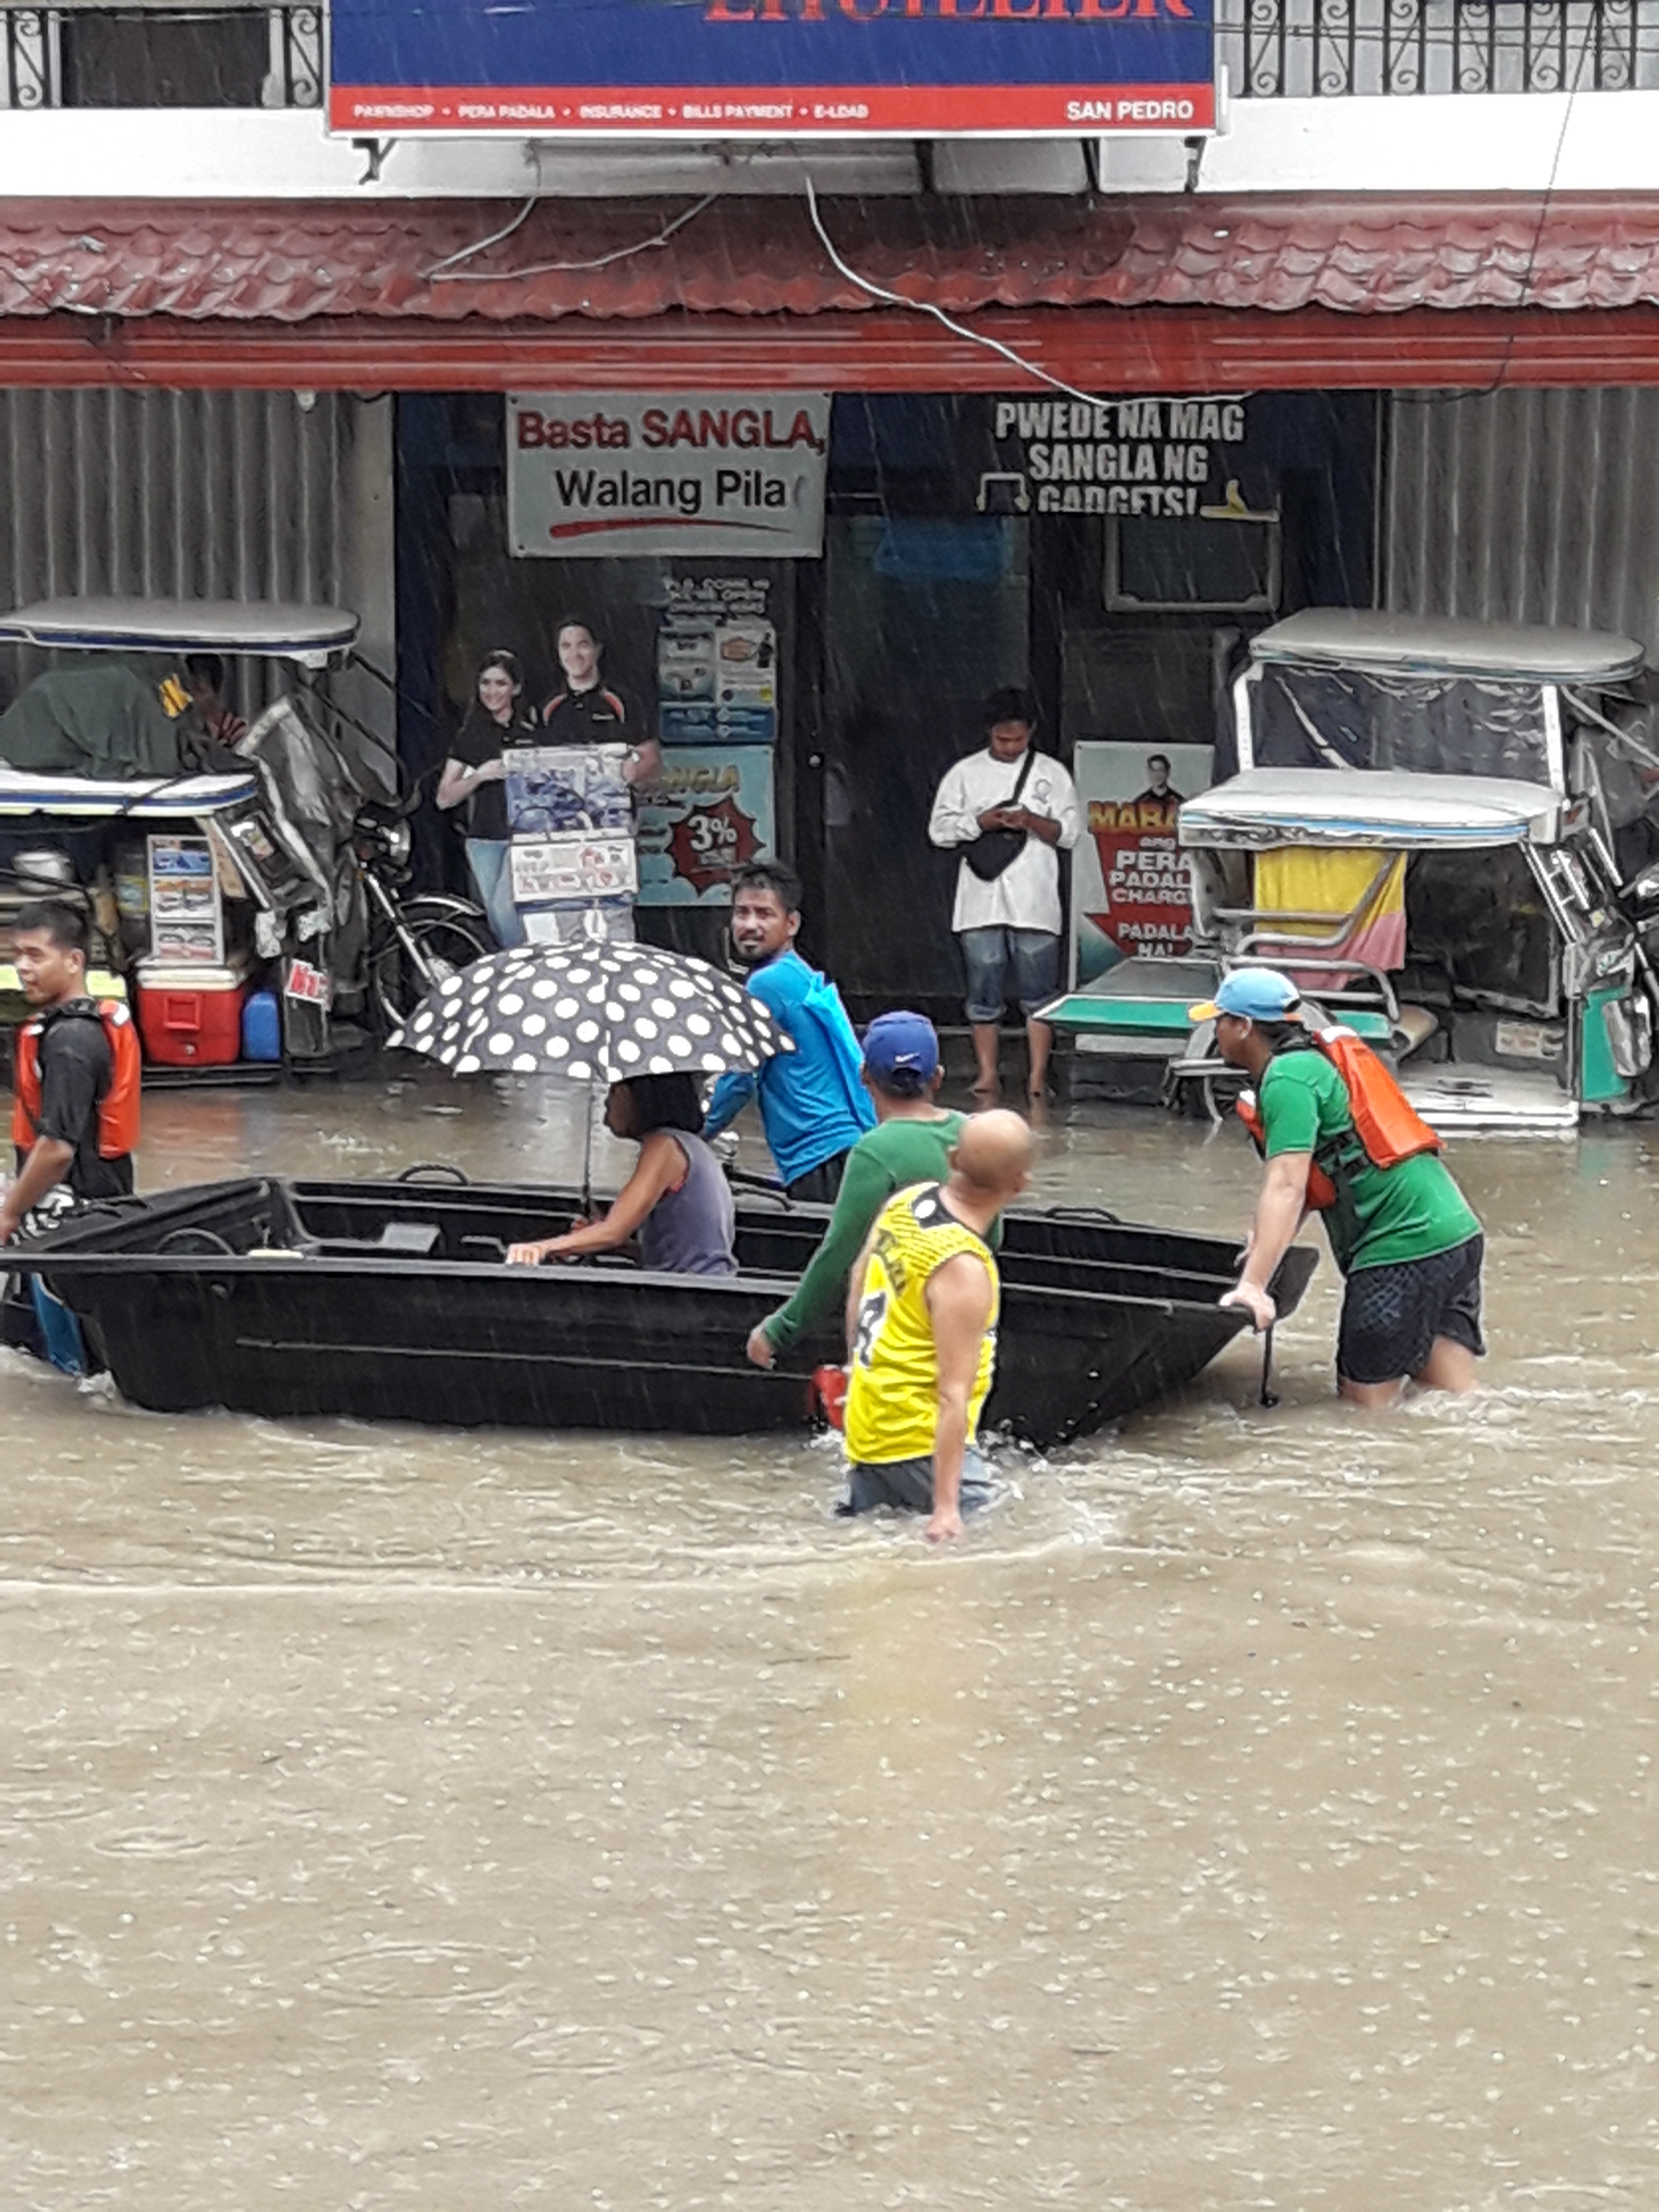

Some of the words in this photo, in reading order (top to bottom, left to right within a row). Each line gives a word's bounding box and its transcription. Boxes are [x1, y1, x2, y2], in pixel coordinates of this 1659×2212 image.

[354, 104, 434, 118] PAWNSHOP
[458, 104, 496, 118] PERA
[499, 104, 555, 118] PADALA
[580, 104, 662, 119] INSURANCE
[682, 104, 722, 119] BILLS
[725, 104, 793, 119] PAYMENT
[1066, 101, 1111, 120] SAN
[1117, 101, 1193, 120] PEDRO
[517, 410, 629, 449] Basta
[642, 408, 825, 454] SANGLA,
[996, 402, 1111, 439] PWEDE
[1118, 402, 1161, 439] NA
[1170, 403, 1245, 441] MAG
[1029, 444, 1156, 481] SANGLA
[1164, 445, 1208, 482] NG
[555, 469, 702, 514] Walang
[716, 469, 786, 506] Pila
[687, 814, 738, 851] 3%
[1117, 851, 1191, 871] PERA
[1109, 871, 1191, 888] PADAL
[1112, 888, 1191, 905] CHARG
